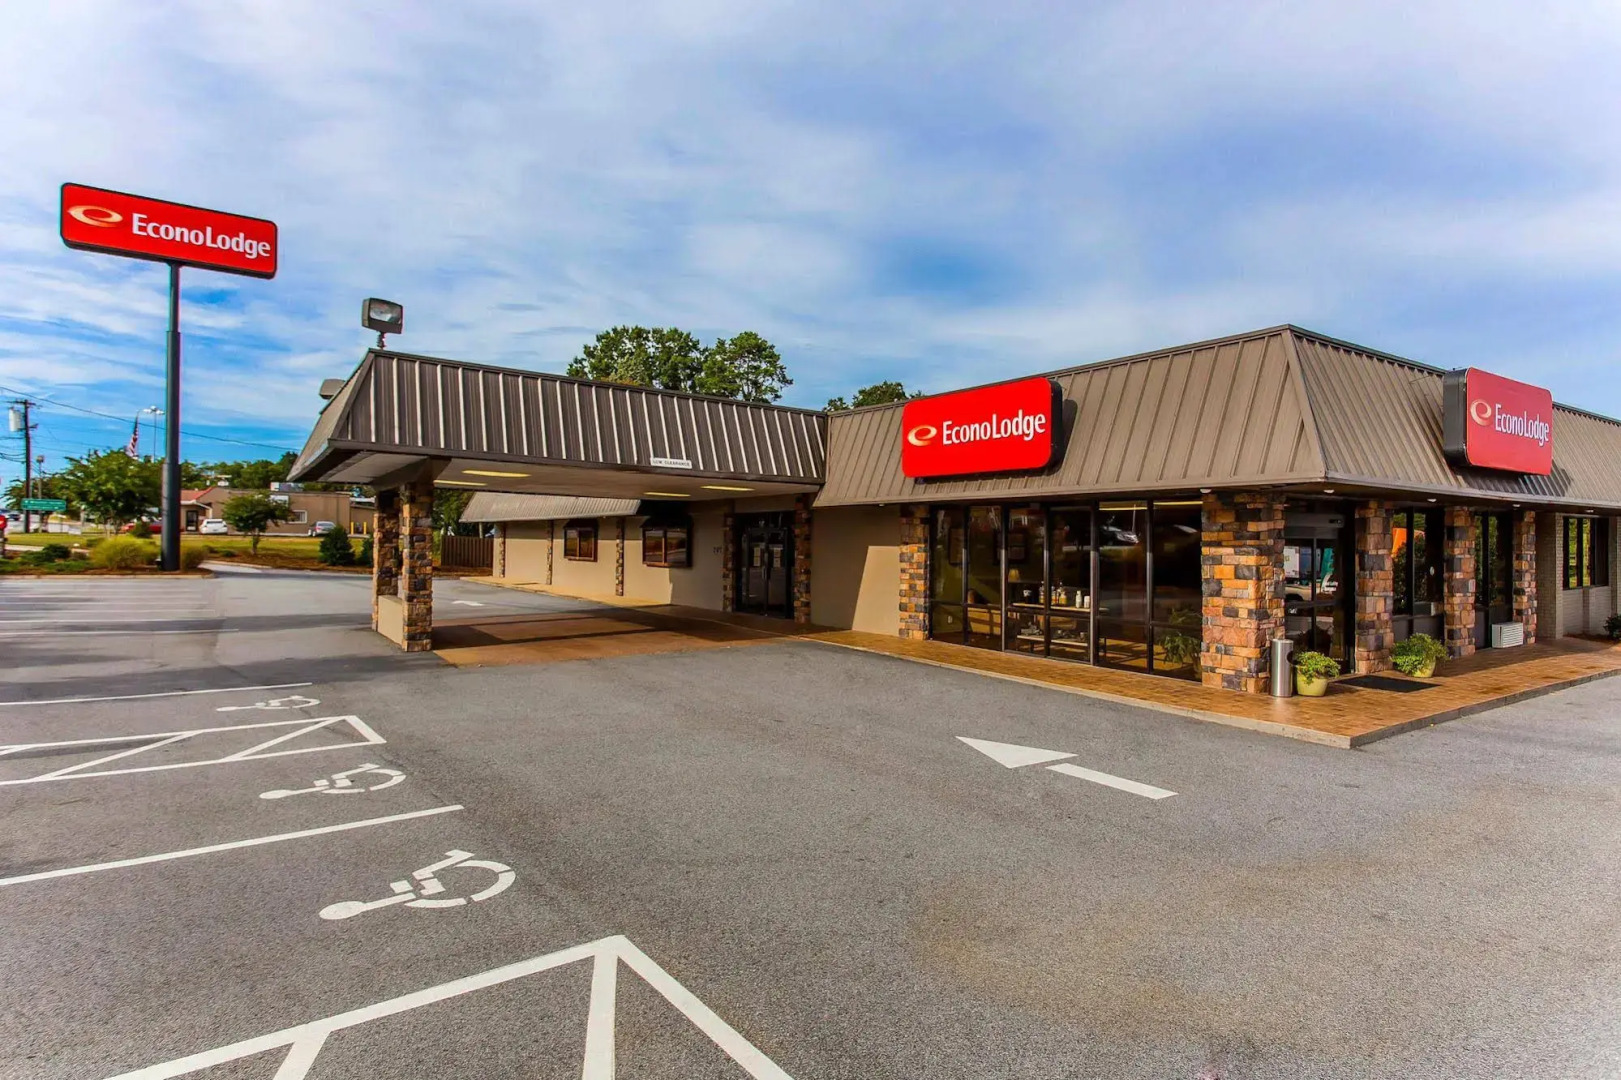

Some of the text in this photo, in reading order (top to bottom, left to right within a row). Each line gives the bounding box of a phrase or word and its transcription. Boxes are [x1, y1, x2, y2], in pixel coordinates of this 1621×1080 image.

[132, 213, 270, 258] EconoLodge
[942, 409, 1046, 445] EconoLodge
[1495, 404, 1549, 446] EconoLodge
